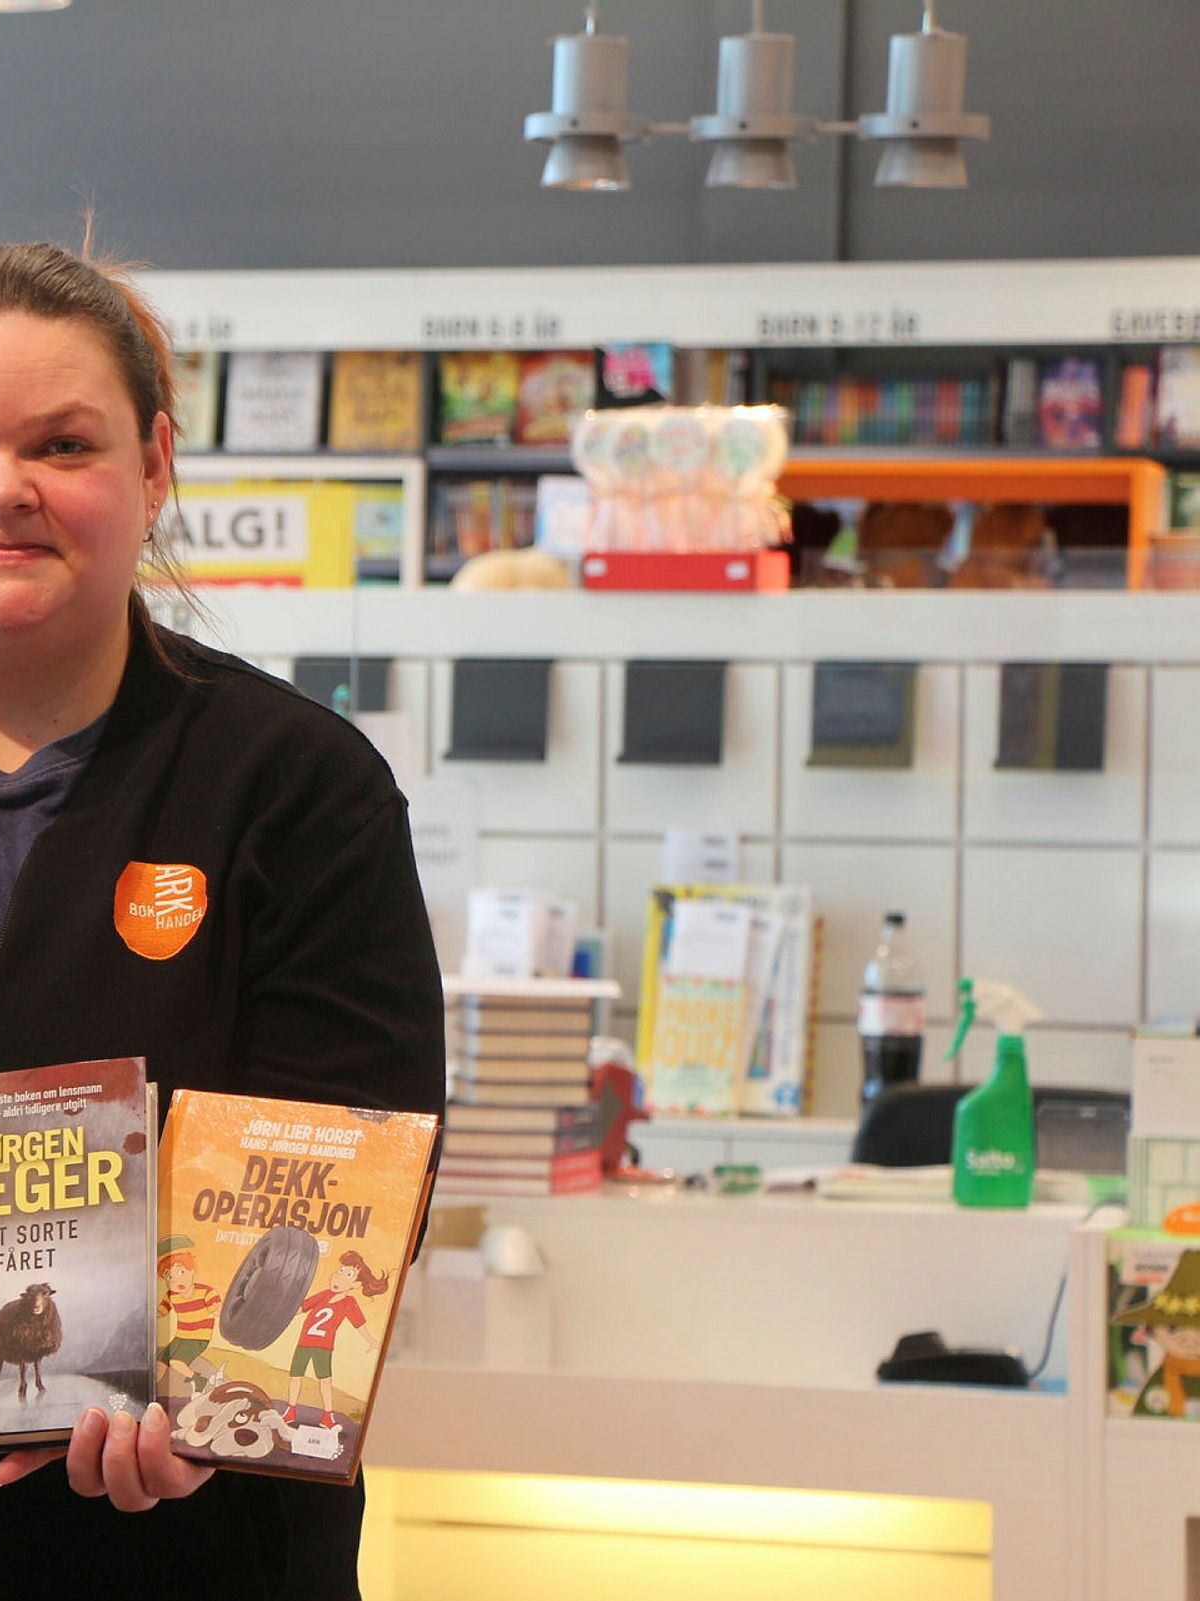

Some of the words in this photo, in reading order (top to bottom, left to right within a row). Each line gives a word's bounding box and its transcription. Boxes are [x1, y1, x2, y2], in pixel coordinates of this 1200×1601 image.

[170, 507, 286, 549] ALG!
[155, 866, 193, 917] ARK
[129, 902, 155, 918] BOK
[156, 906, 203, 930] HANDEL
[14, 1091, 41, 1103] boken
[43, 1089, 57, 1099] om
[59, 1083, 103, 1097] lensmann
[2, 1106, 23, 1118] aldri
[25, 1102, 61, 1117] tidligere
[63, 1097, 87, 1112] utgitt
[243, 1119, 282, 1138] JØRN
[284, 1123, 312, 1142] LIER
[315, 1126, 362, 1145] HORST
[240, 1137, 267, 1151] HANS
[269, 1140, 307, 1155] JØRGEN
[309, 1143, 356, 1160] SANDNES
[240, 1154, 338, 1200] DEKK-
[192, 1188, 372, 1238] OPERASJON
[16, 1219, 79, 1244] SORTE
[307, 1307, 333, 1337] 2
